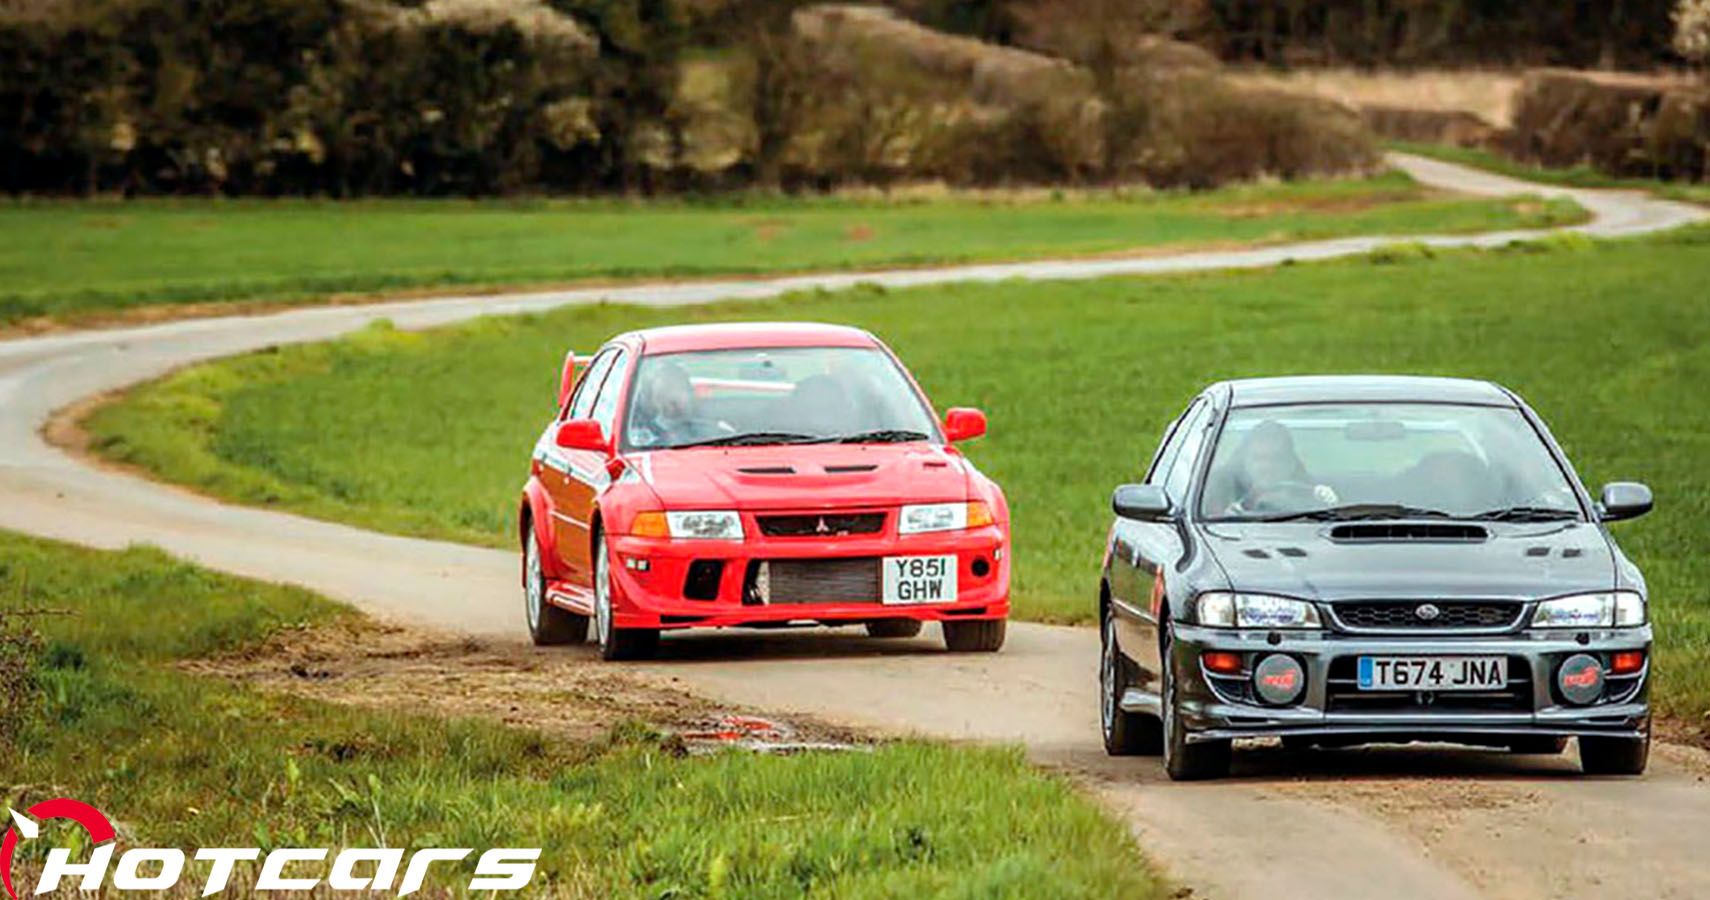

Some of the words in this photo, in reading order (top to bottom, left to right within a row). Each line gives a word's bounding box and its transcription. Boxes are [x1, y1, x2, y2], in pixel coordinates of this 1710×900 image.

[895, 557, 946, 578] Y851
[897, 579, 942, 600] GHW
[1376, 660, 1444, 686] T674
[1452, 660, 1502, 686] JNA
